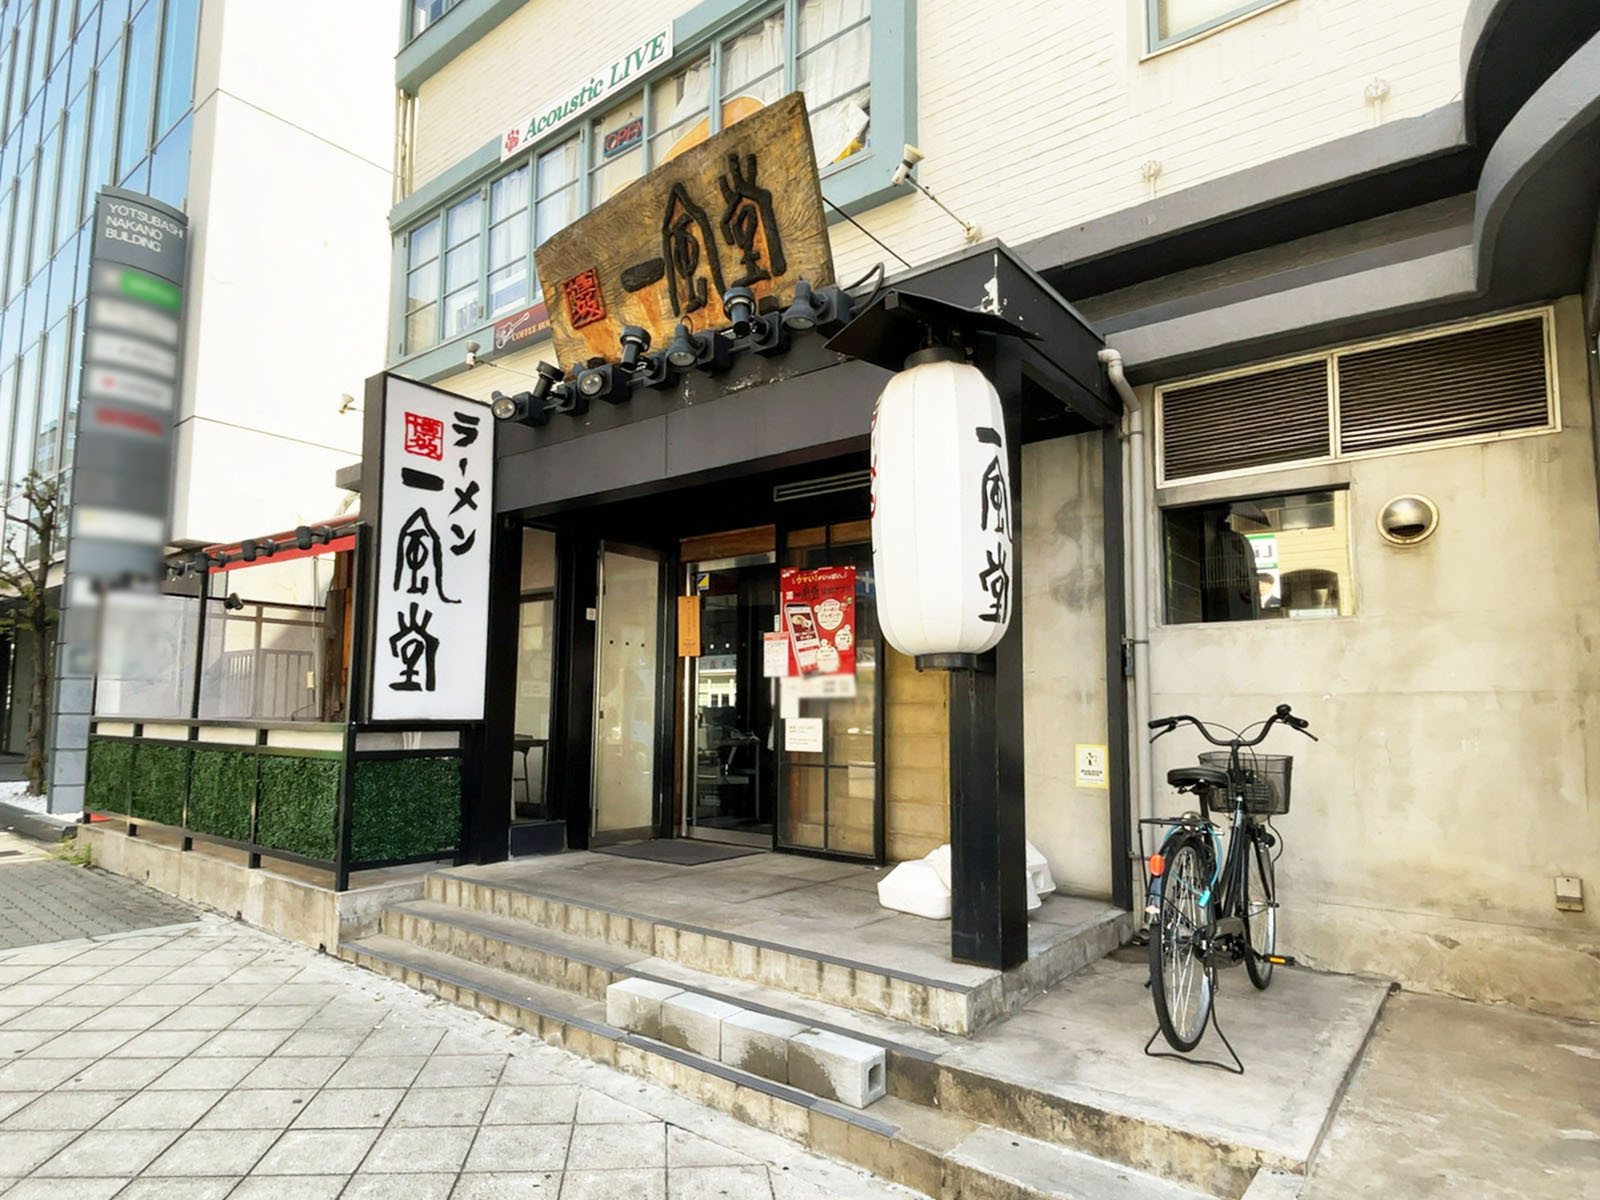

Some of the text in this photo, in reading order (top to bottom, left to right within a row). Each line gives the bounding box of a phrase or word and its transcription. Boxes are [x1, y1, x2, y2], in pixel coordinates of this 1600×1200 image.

[523, 31, 666, 143] Acoustic LIVE
[606, 120, 643, 150] OPEN
[105, 228, 161, 252] BUILDING
[106, 215, 163, 240] NAKANO
[449, 411, 480, 556] ラーメン
[389, 466, 462, 692] 一風堂
